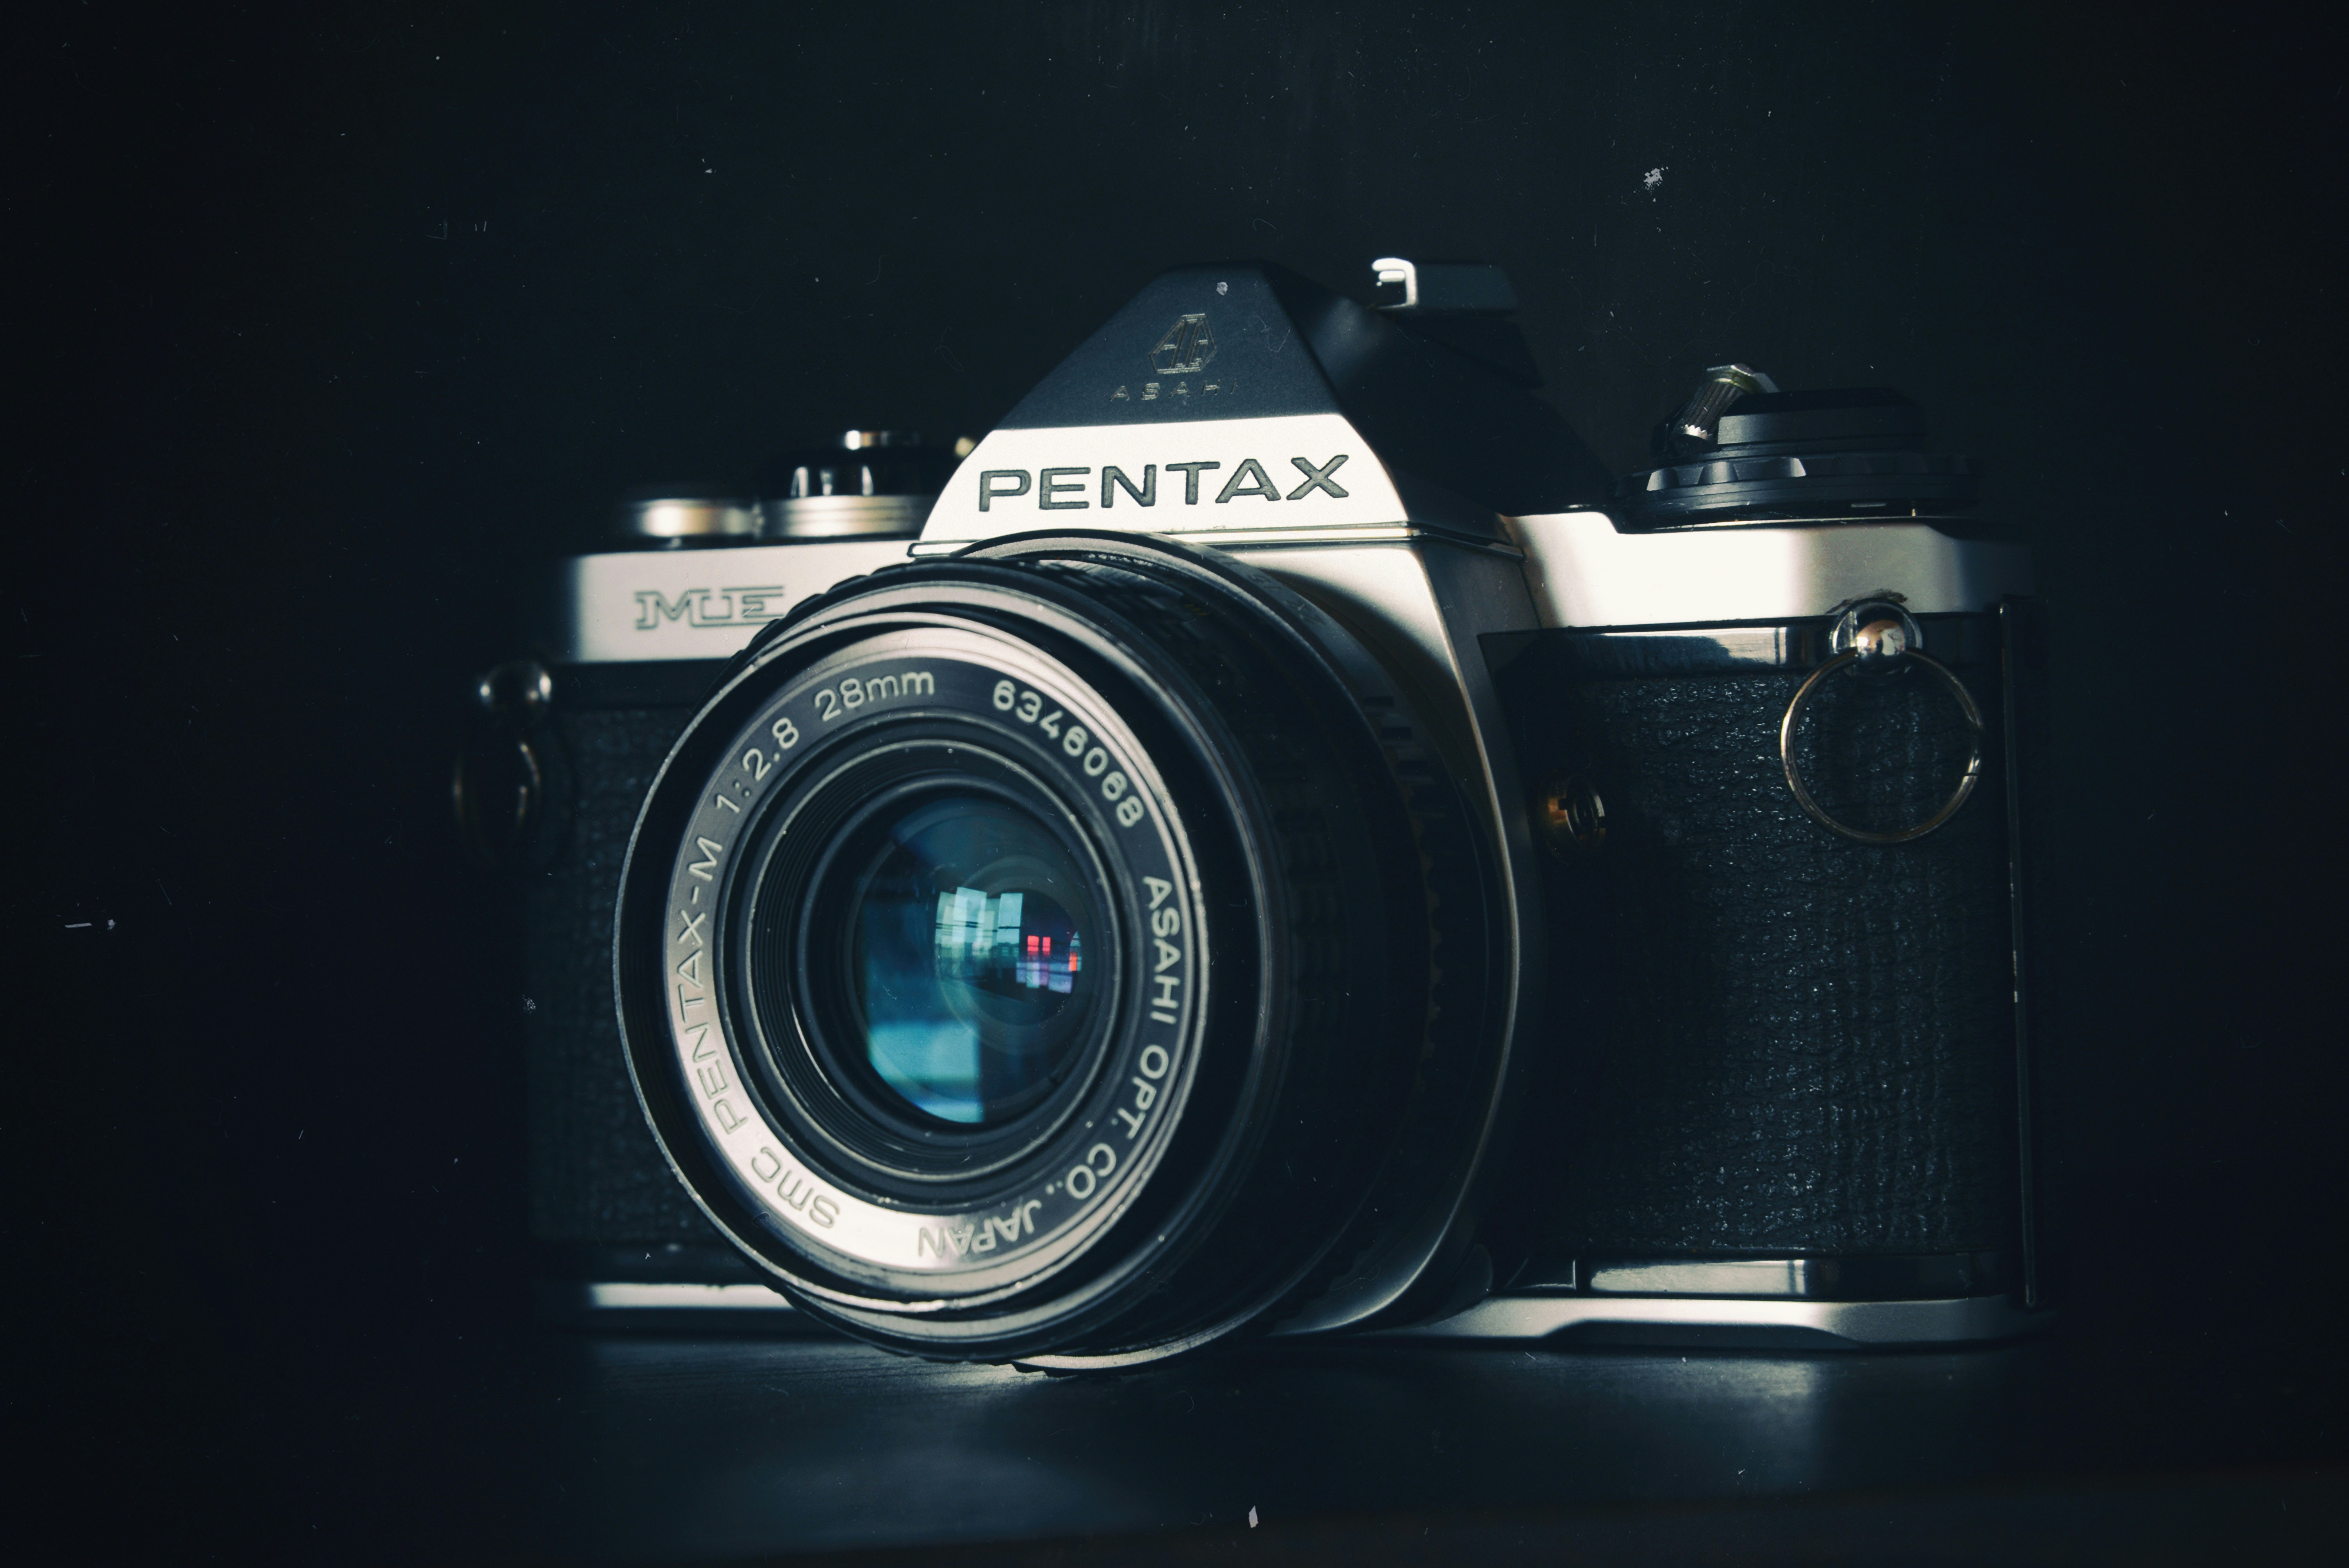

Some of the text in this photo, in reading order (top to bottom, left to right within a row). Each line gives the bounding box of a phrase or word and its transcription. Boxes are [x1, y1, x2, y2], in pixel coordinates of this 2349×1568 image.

[1109, 380, 1237, 401] ASAHI
[979, 455, 1348, 512] PENTAX
[634, 586, 783, 629] ME
[993, 680, 1144, 827] 6346068
[677, 836, 749, 1134] PENTAX-M
[715, 717, 799, 813] 1:2.8
[815, 672, 934, 722] 28mm
[1143, 876, 1180, 1024] ASAHI
[1111, 1045, 1169, 1139] OPT.
[918, 1199, 1042, 1258] JAPAN
